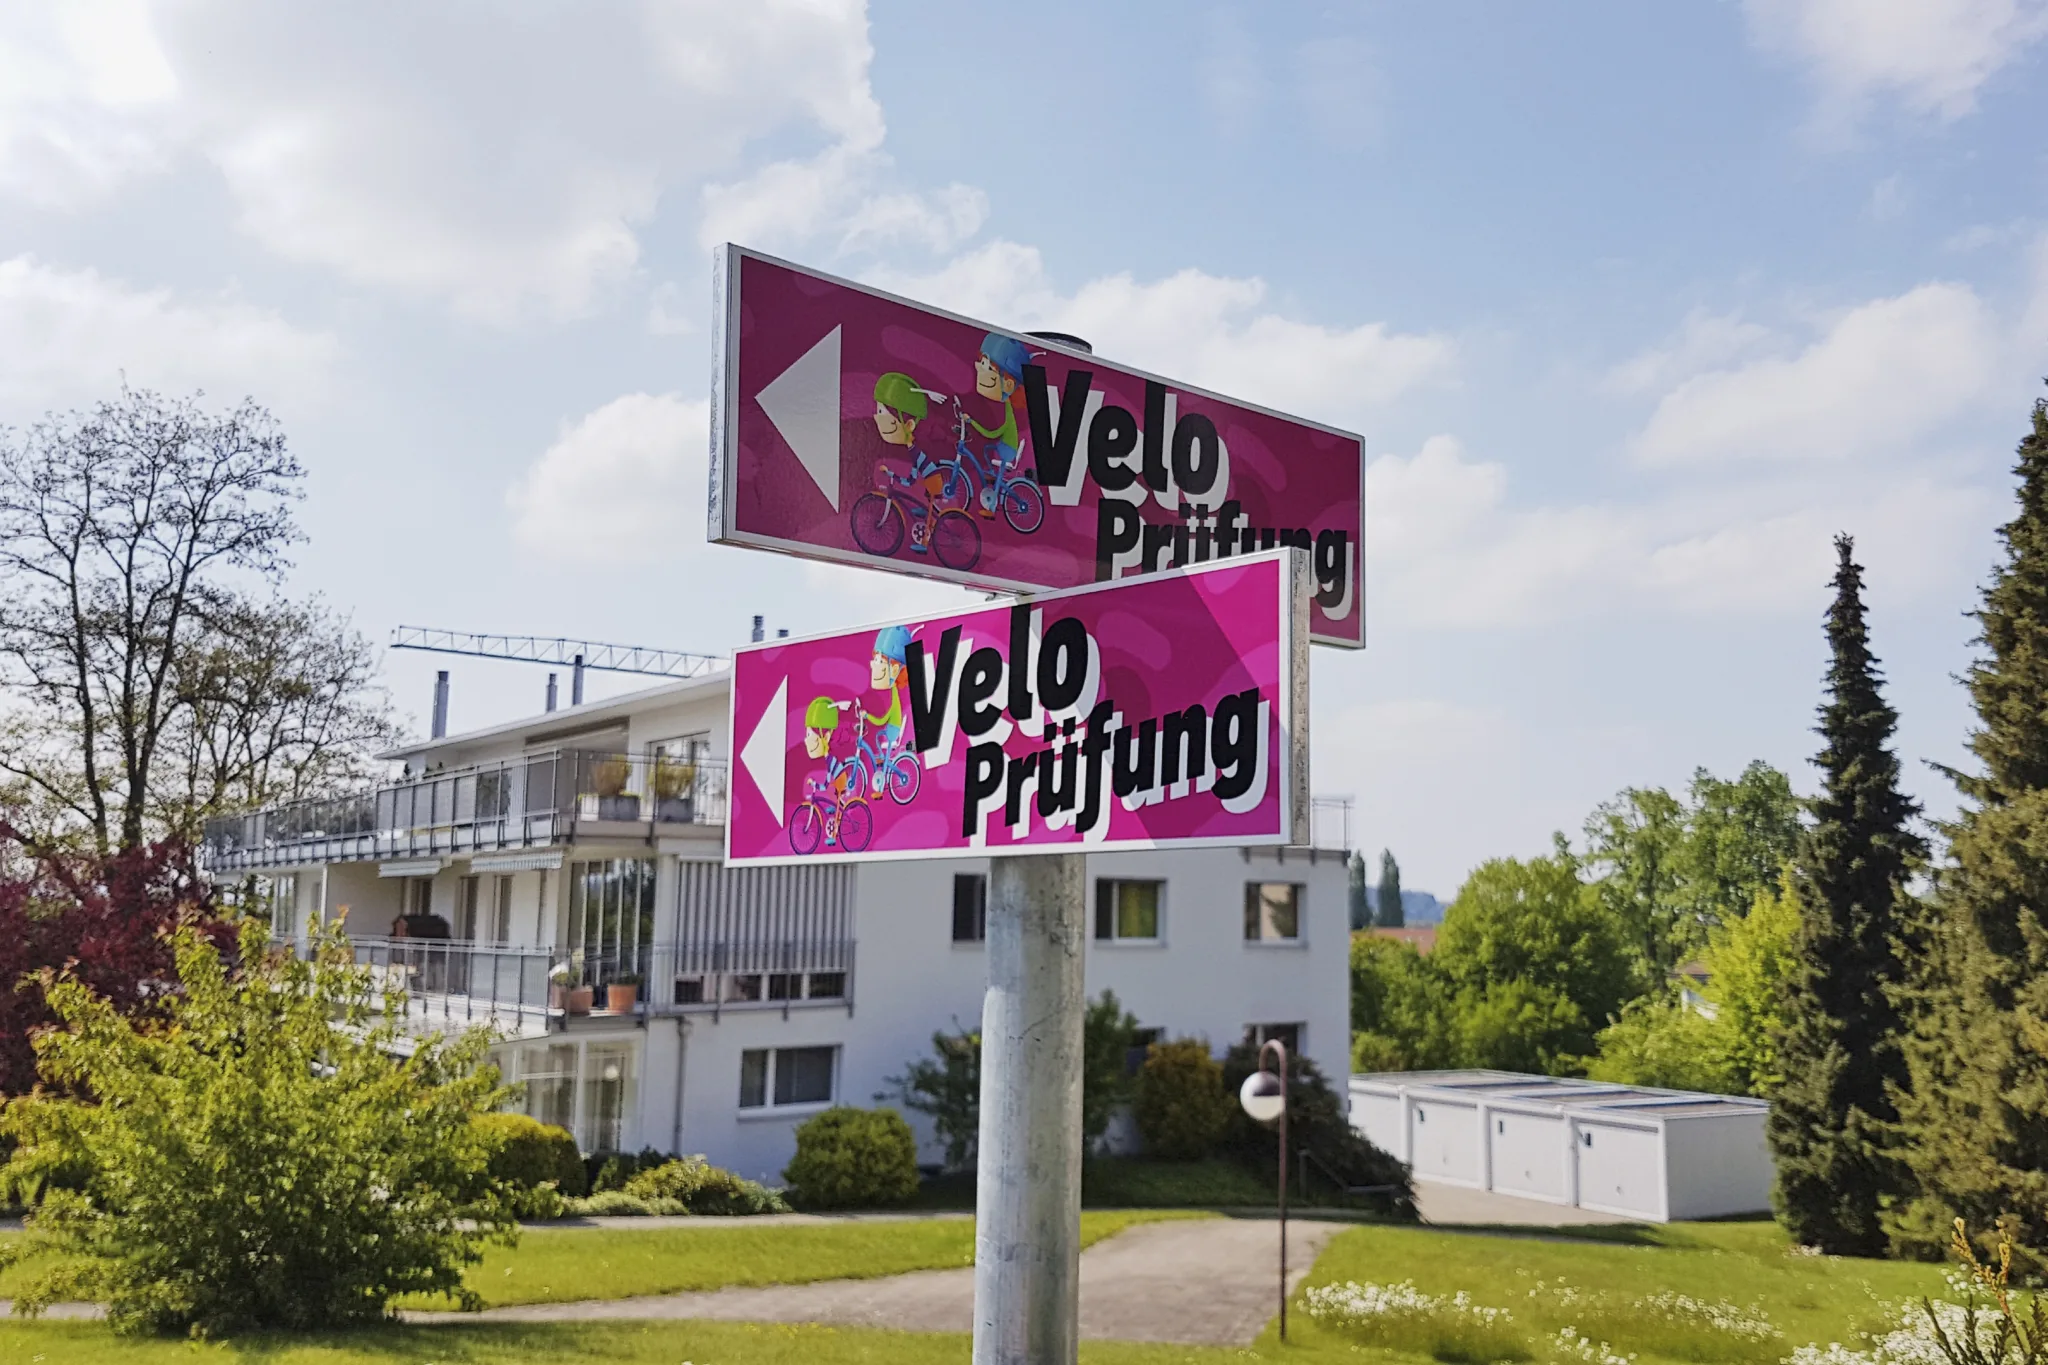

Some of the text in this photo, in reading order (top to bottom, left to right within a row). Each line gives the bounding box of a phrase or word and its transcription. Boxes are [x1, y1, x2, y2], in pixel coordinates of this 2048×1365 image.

[1021, 364, 1219, 495] Velo
[904, 603, 1089, 755] Velo
[962, 687, 1260, 838] Prüfung
